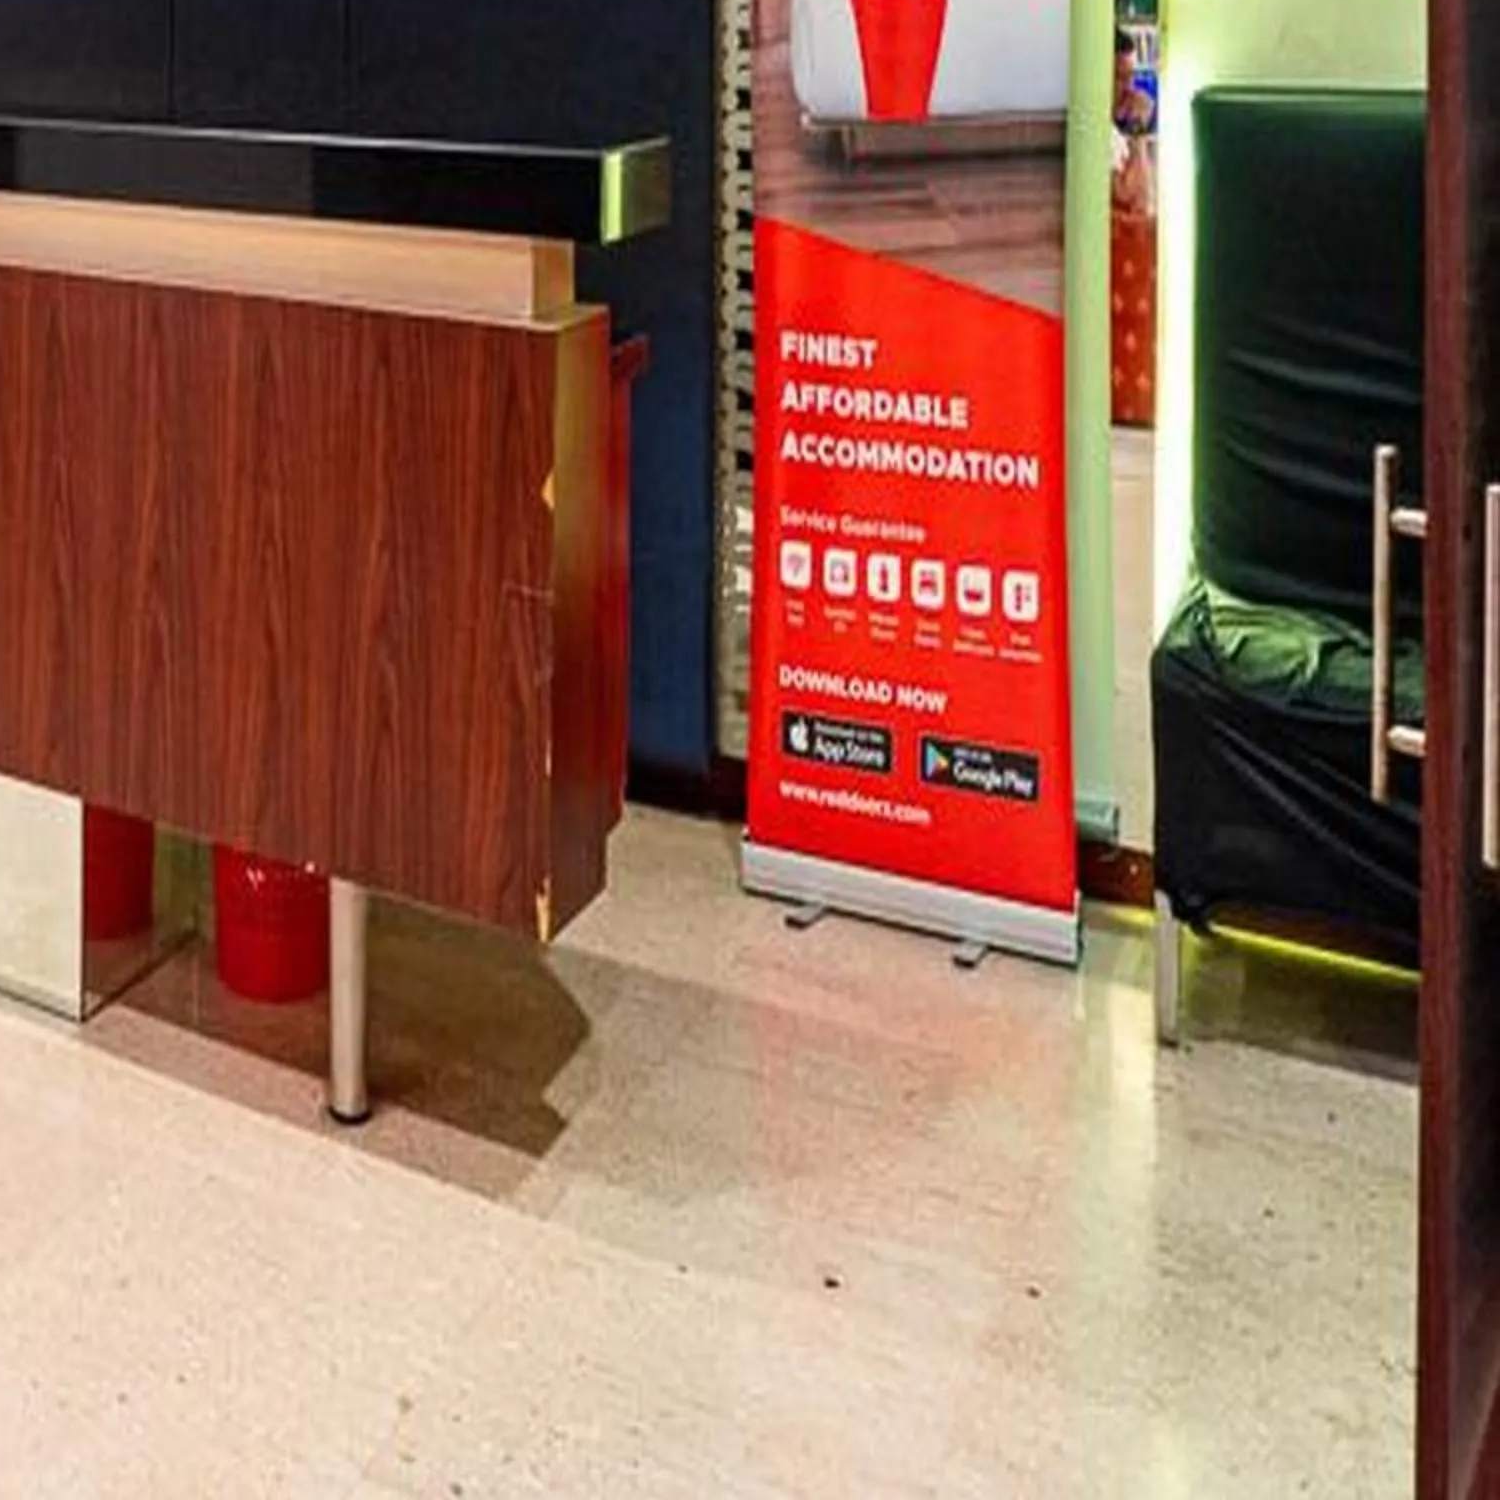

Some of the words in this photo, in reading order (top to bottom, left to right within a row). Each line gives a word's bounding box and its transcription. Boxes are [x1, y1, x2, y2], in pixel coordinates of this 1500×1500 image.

[780, 331, 877, 369] FINEST
[781, 381, 969, 429] AFFORDABLE
[781, 430, 1040, 487] ACCOMMODATION
[780, 505, 836, 534] Service
[779, 664, 893, 705] DOWNLOAD
[896, 683, 948, 714] NOW
